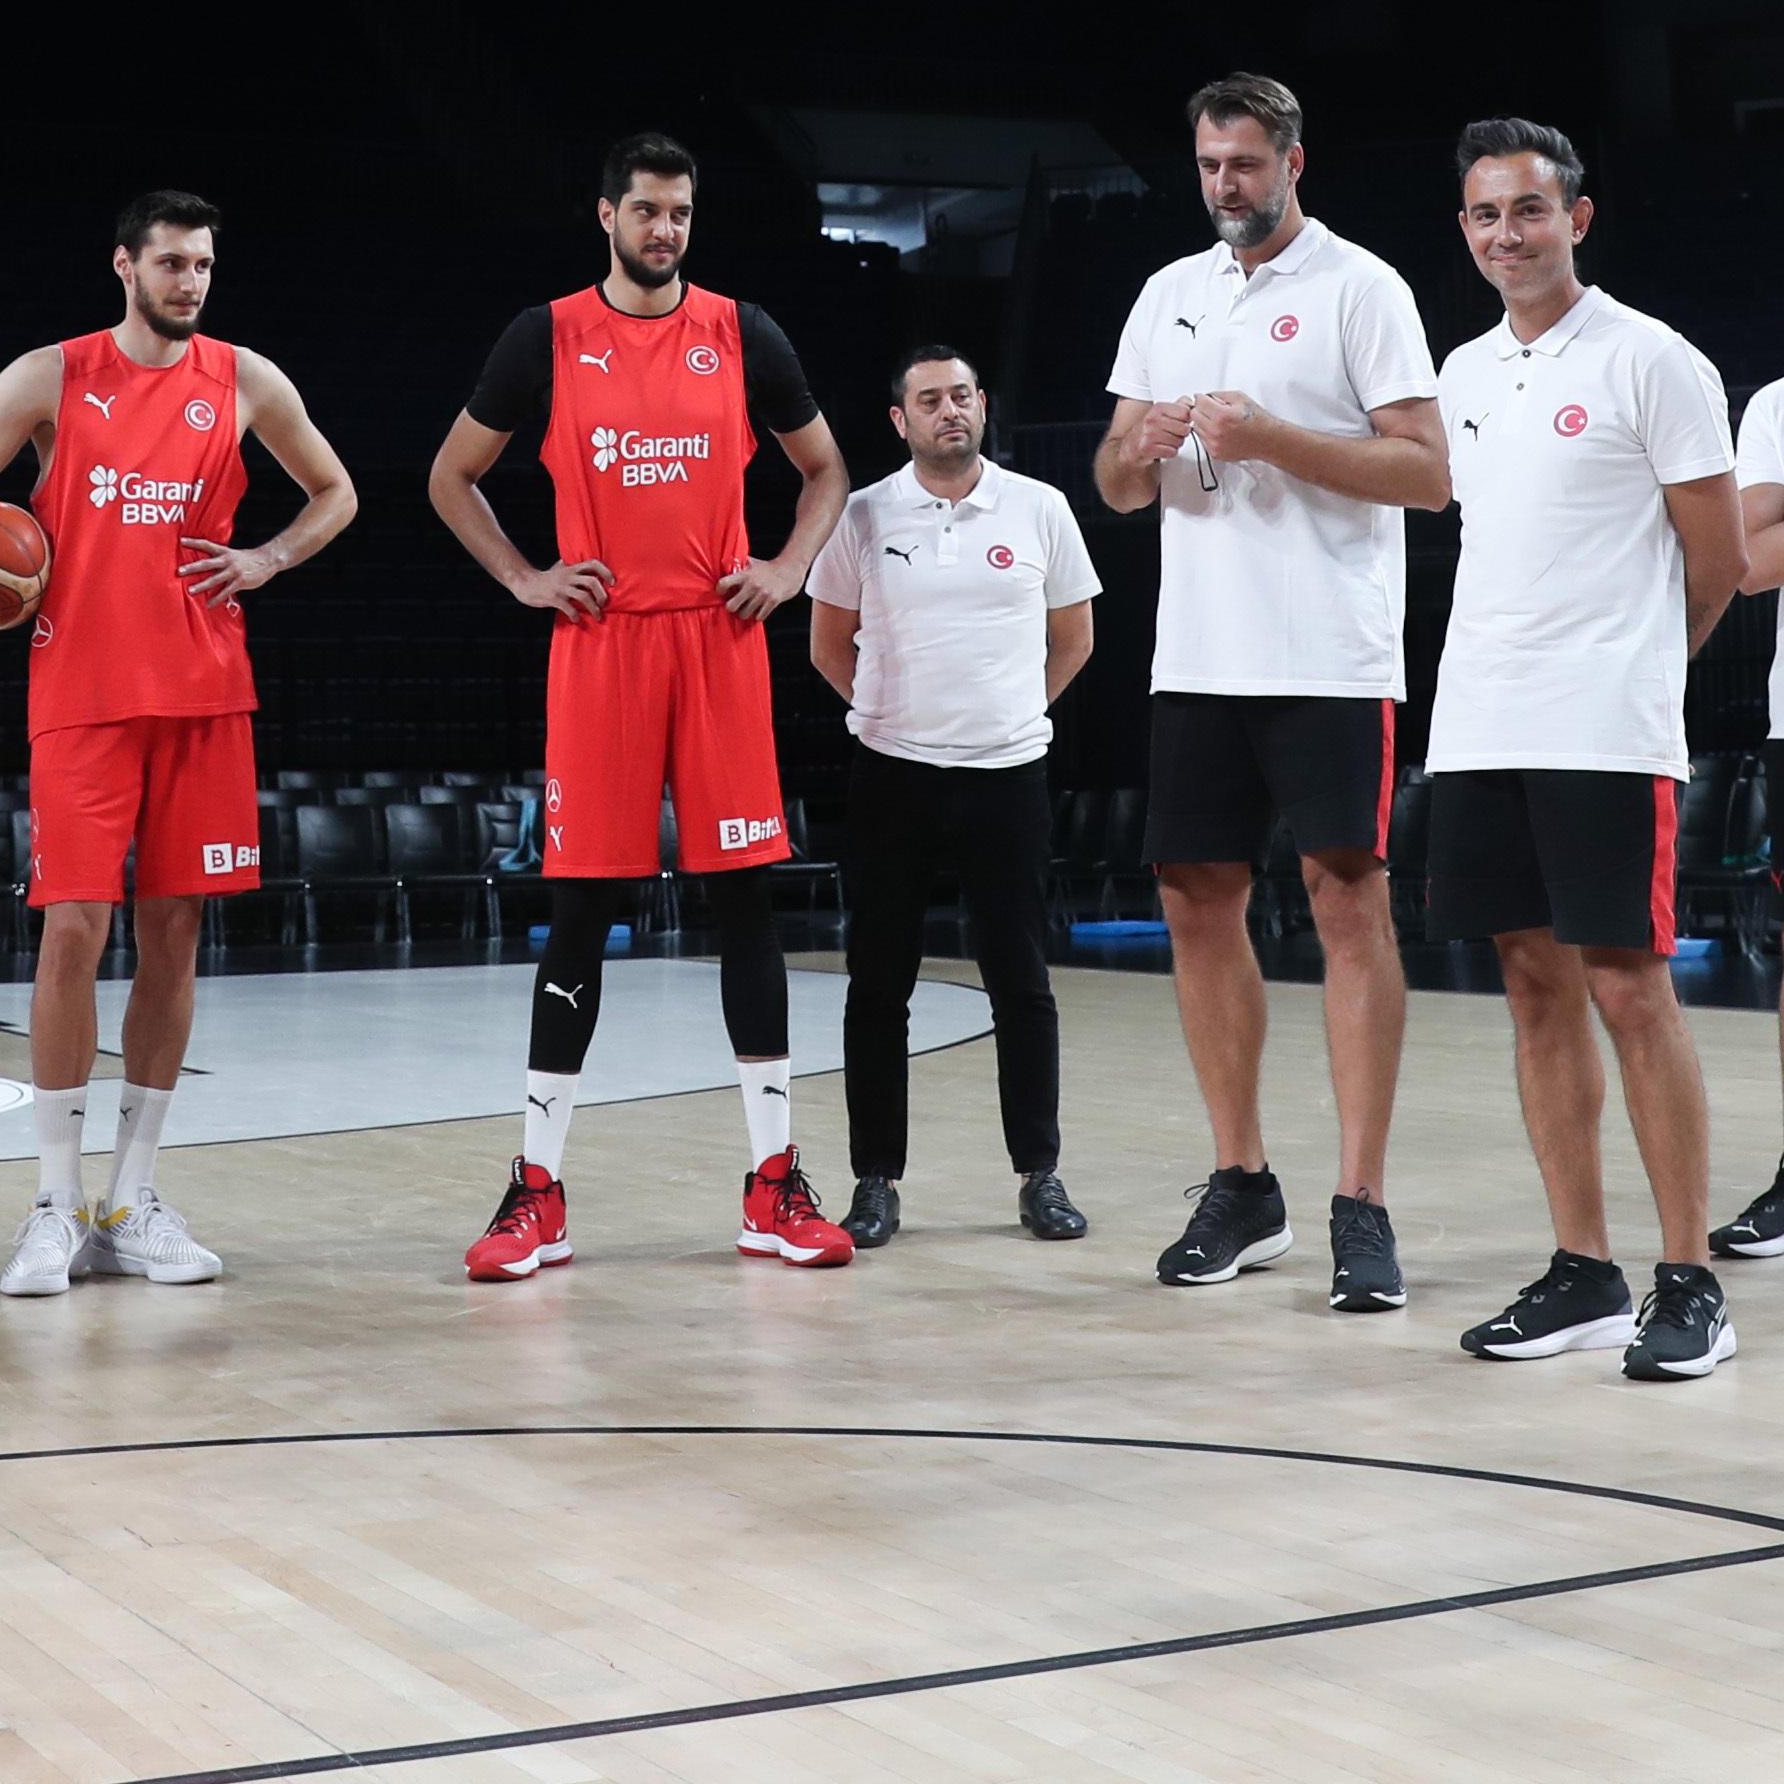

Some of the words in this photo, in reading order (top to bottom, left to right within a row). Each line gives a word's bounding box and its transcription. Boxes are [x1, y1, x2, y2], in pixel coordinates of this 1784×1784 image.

[620, 430, 709, 460] Garanti
[622, 460, 689, 487] BBVA
[121, 503, 185, 525] BBVA
